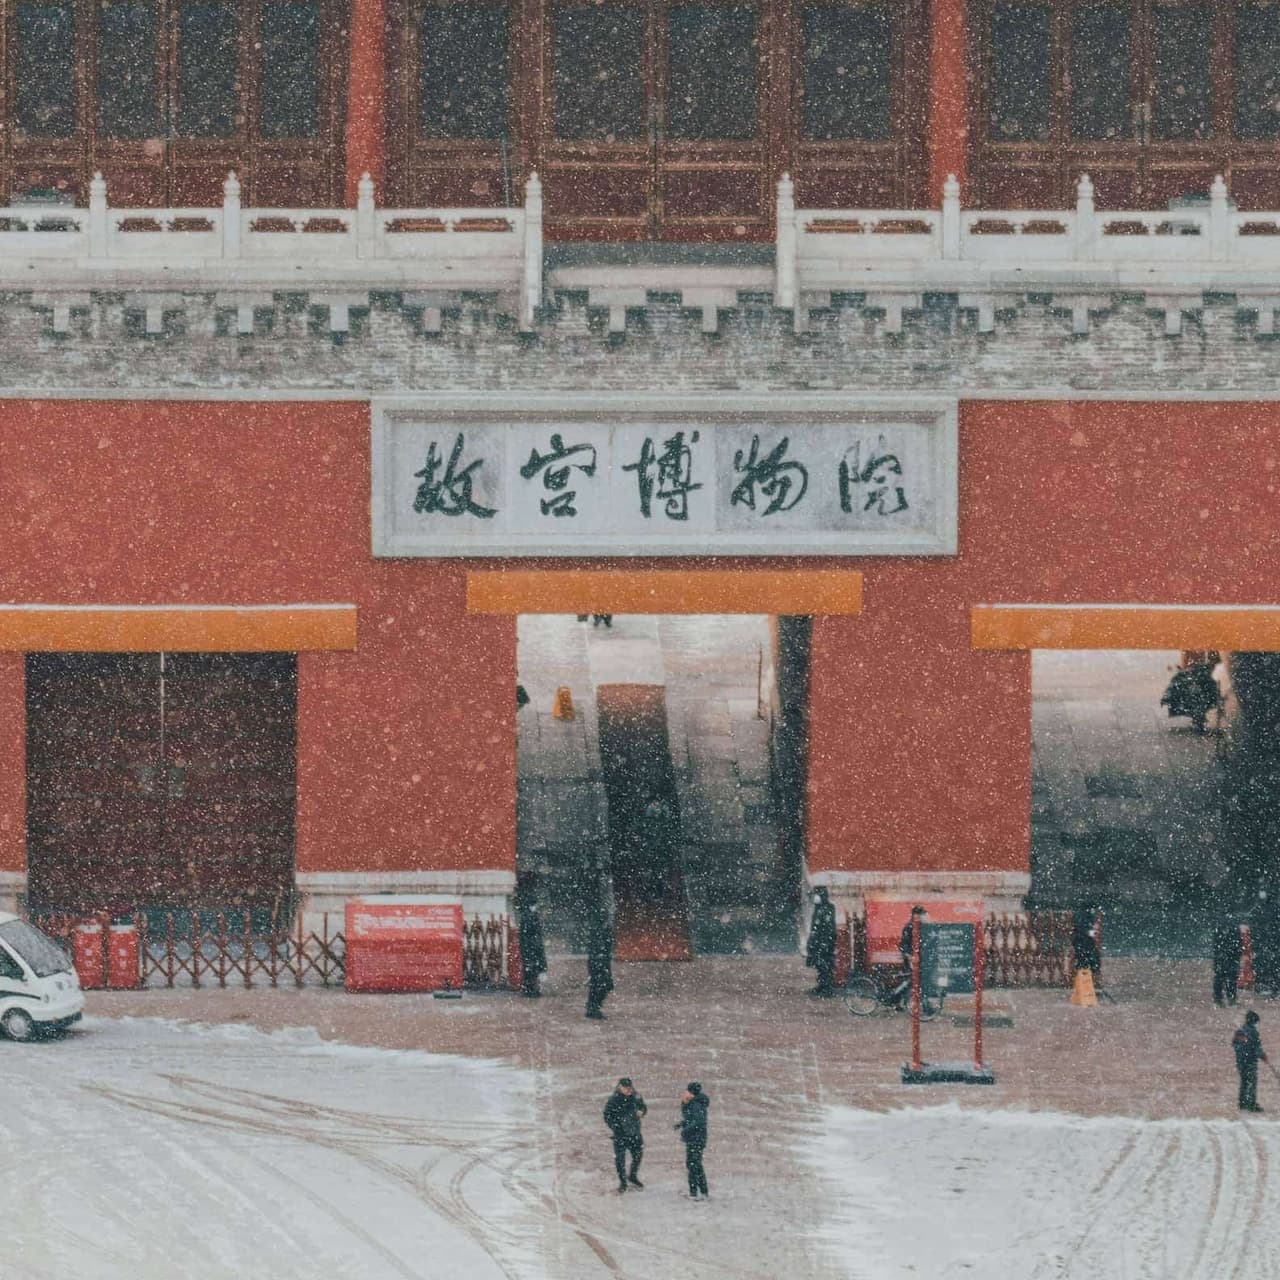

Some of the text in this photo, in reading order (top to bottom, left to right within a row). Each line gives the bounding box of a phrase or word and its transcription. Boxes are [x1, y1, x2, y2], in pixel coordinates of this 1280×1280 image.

[412, 430, 910, 520] 故宫博物院
